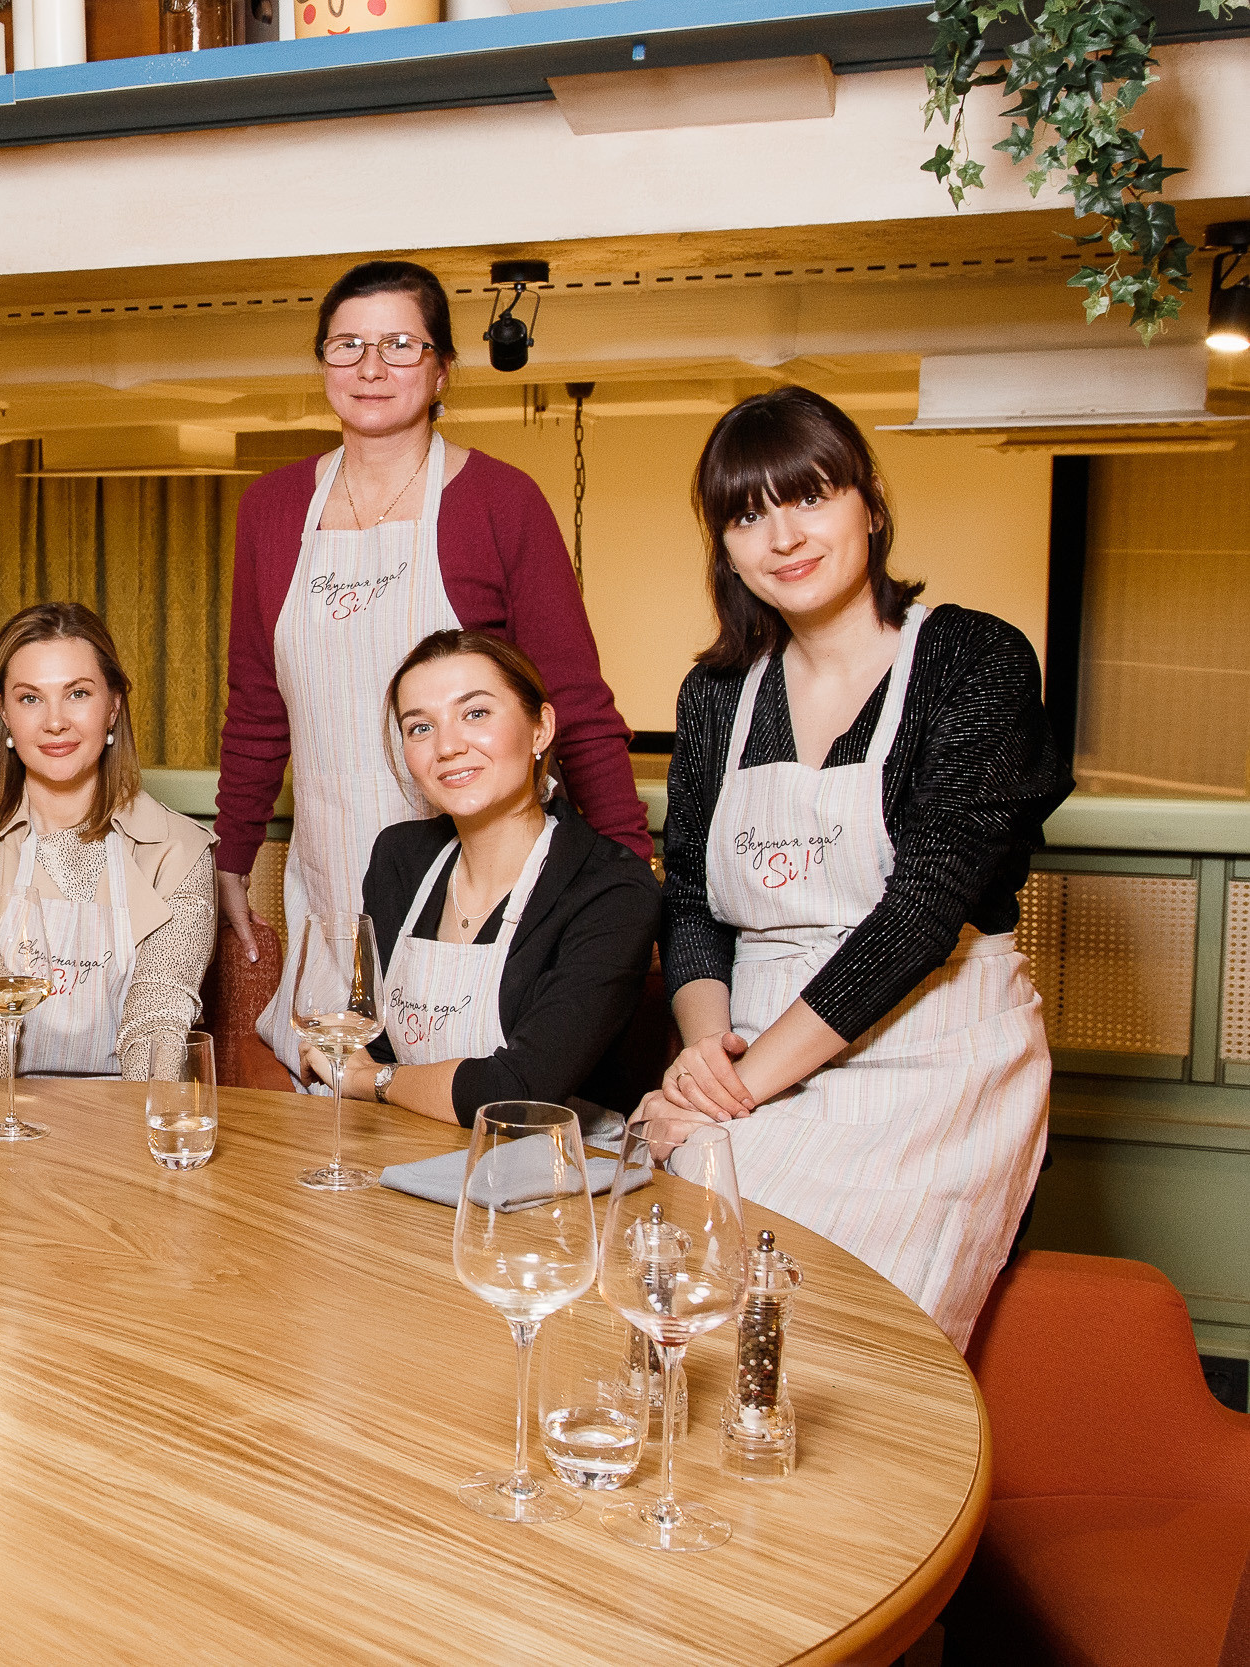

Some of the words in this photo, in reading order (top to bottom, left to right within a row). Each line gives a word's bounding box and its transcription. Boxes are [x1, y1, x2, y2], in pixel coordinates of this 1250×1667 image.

[376, 561, 408, 598] еда?
[332, 587, 376, 620] Si!
[734, 826, 803, 870] Вкусная
[808, 824, 843, 865] еда?
[762, 849, 810, 889] Si!
[79, 950, 113, 985] еда?
[404, 1012, 434, 1045] Si!
[433, 995, 472, 1031] еда?
